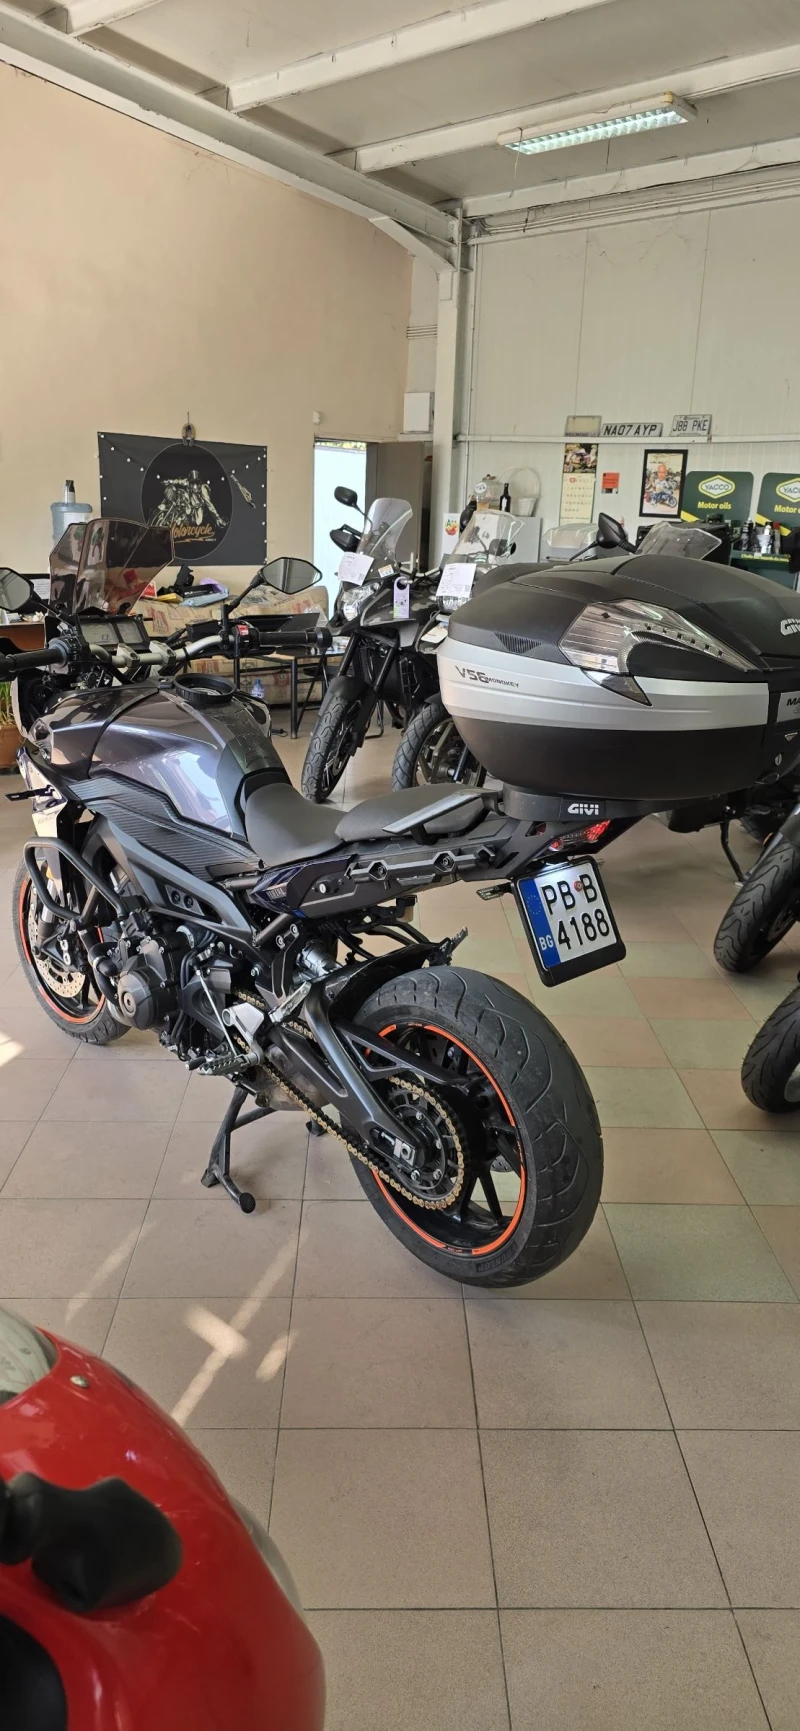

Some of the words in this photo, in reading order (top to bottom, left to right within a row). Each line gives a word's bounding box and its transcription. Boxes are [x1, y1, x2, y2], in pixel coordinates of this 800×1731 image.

[603, 424, 633, 436] NA07
[634, 424, 657, 436] AYP
[672, 420, 689, 432] J88
[692, 419, 708, 432] PKE
[697, 501, 719, 509] Motor
[719, 502, 732, 510] oils
[774, 504, 798, 513] Motor
[454, 665, 490, 684] V56
[567, 803, 599, 815] GIVI
[540, 880, 576, 915] PB
[579, 873, 598, 904] B
[557, 908, 610, 950] 4188
[538, 936, 554, 951] BG
